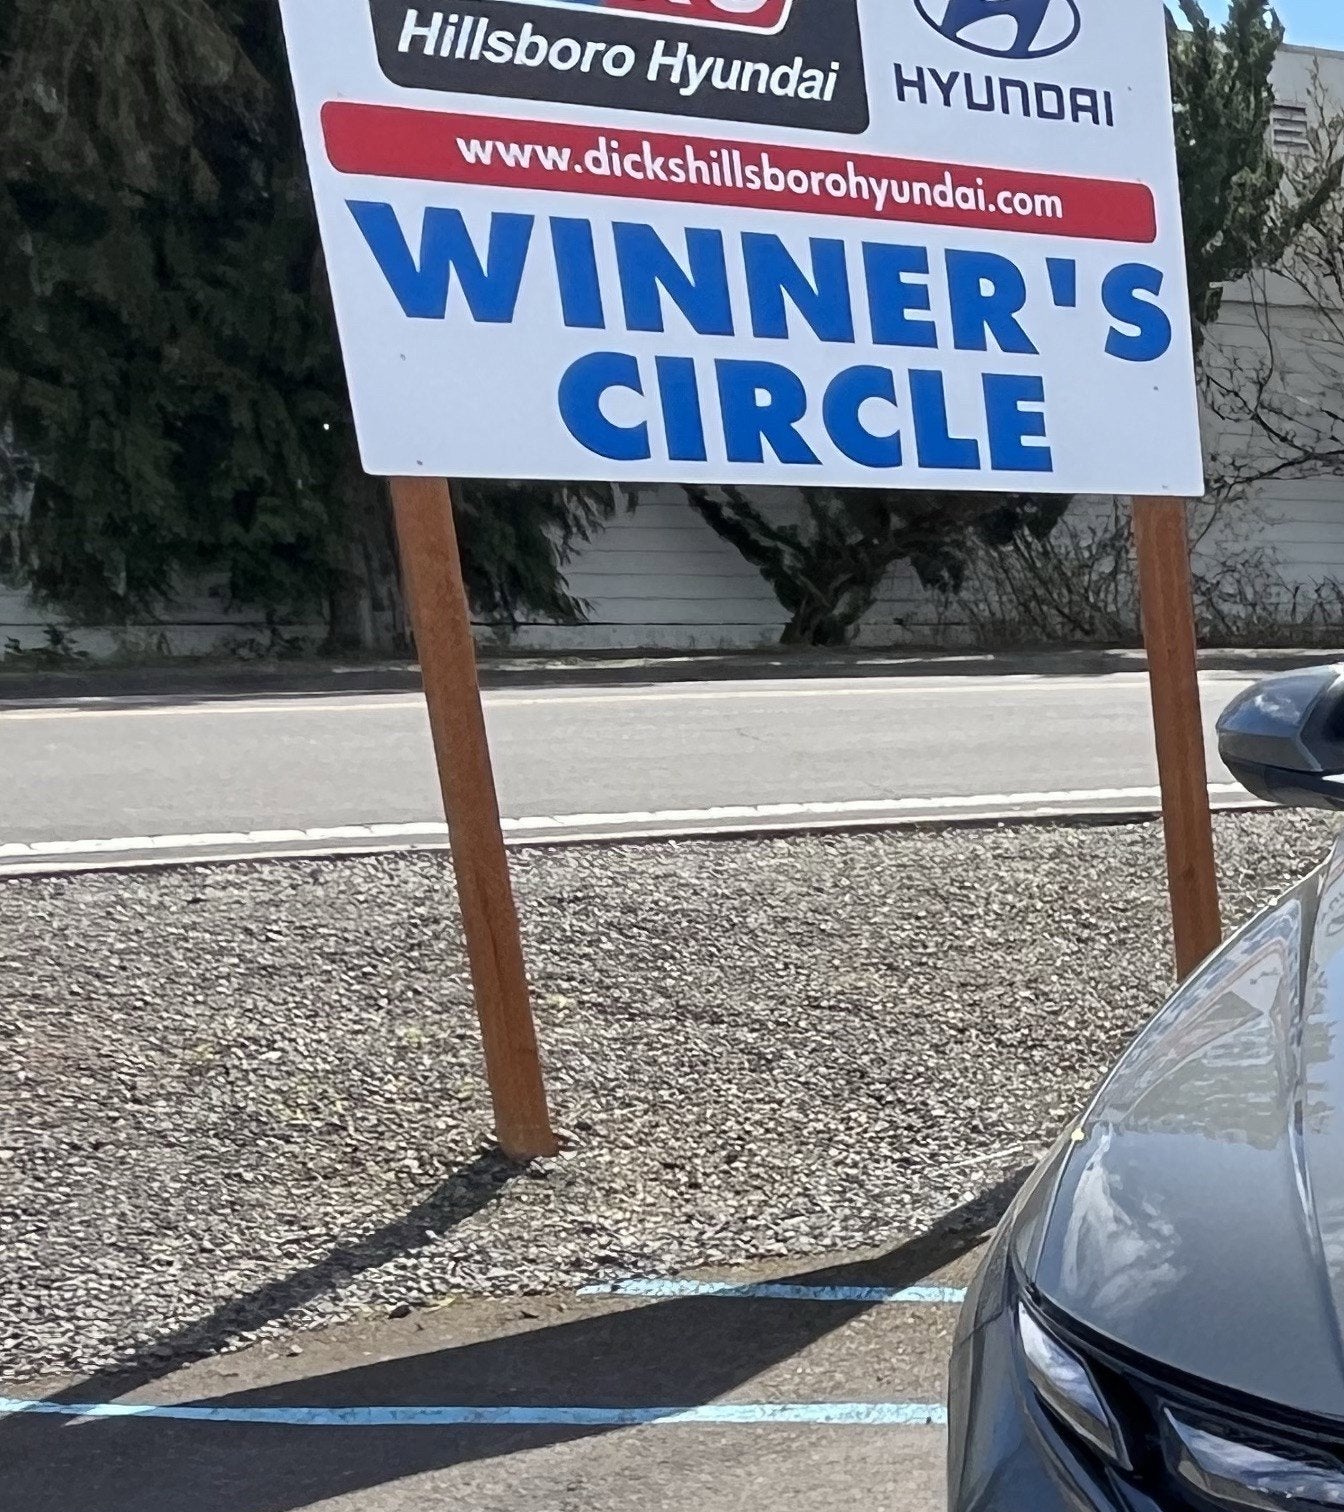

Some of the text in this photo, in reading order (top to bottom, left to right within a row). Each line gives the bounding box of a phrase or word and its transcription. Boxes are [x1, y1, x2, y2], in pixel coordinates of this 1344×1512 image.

[398, 8, 840, 102] Hillsboro Hyundai
[893, 62, 1114, 127] HYUNDAI
[455, 133, 1065, 221] www.dickshillsborohyundai.com
[345, 199, 1173, 363] WINNER'S
[558, 351, 1053, 473] CIRCLE
